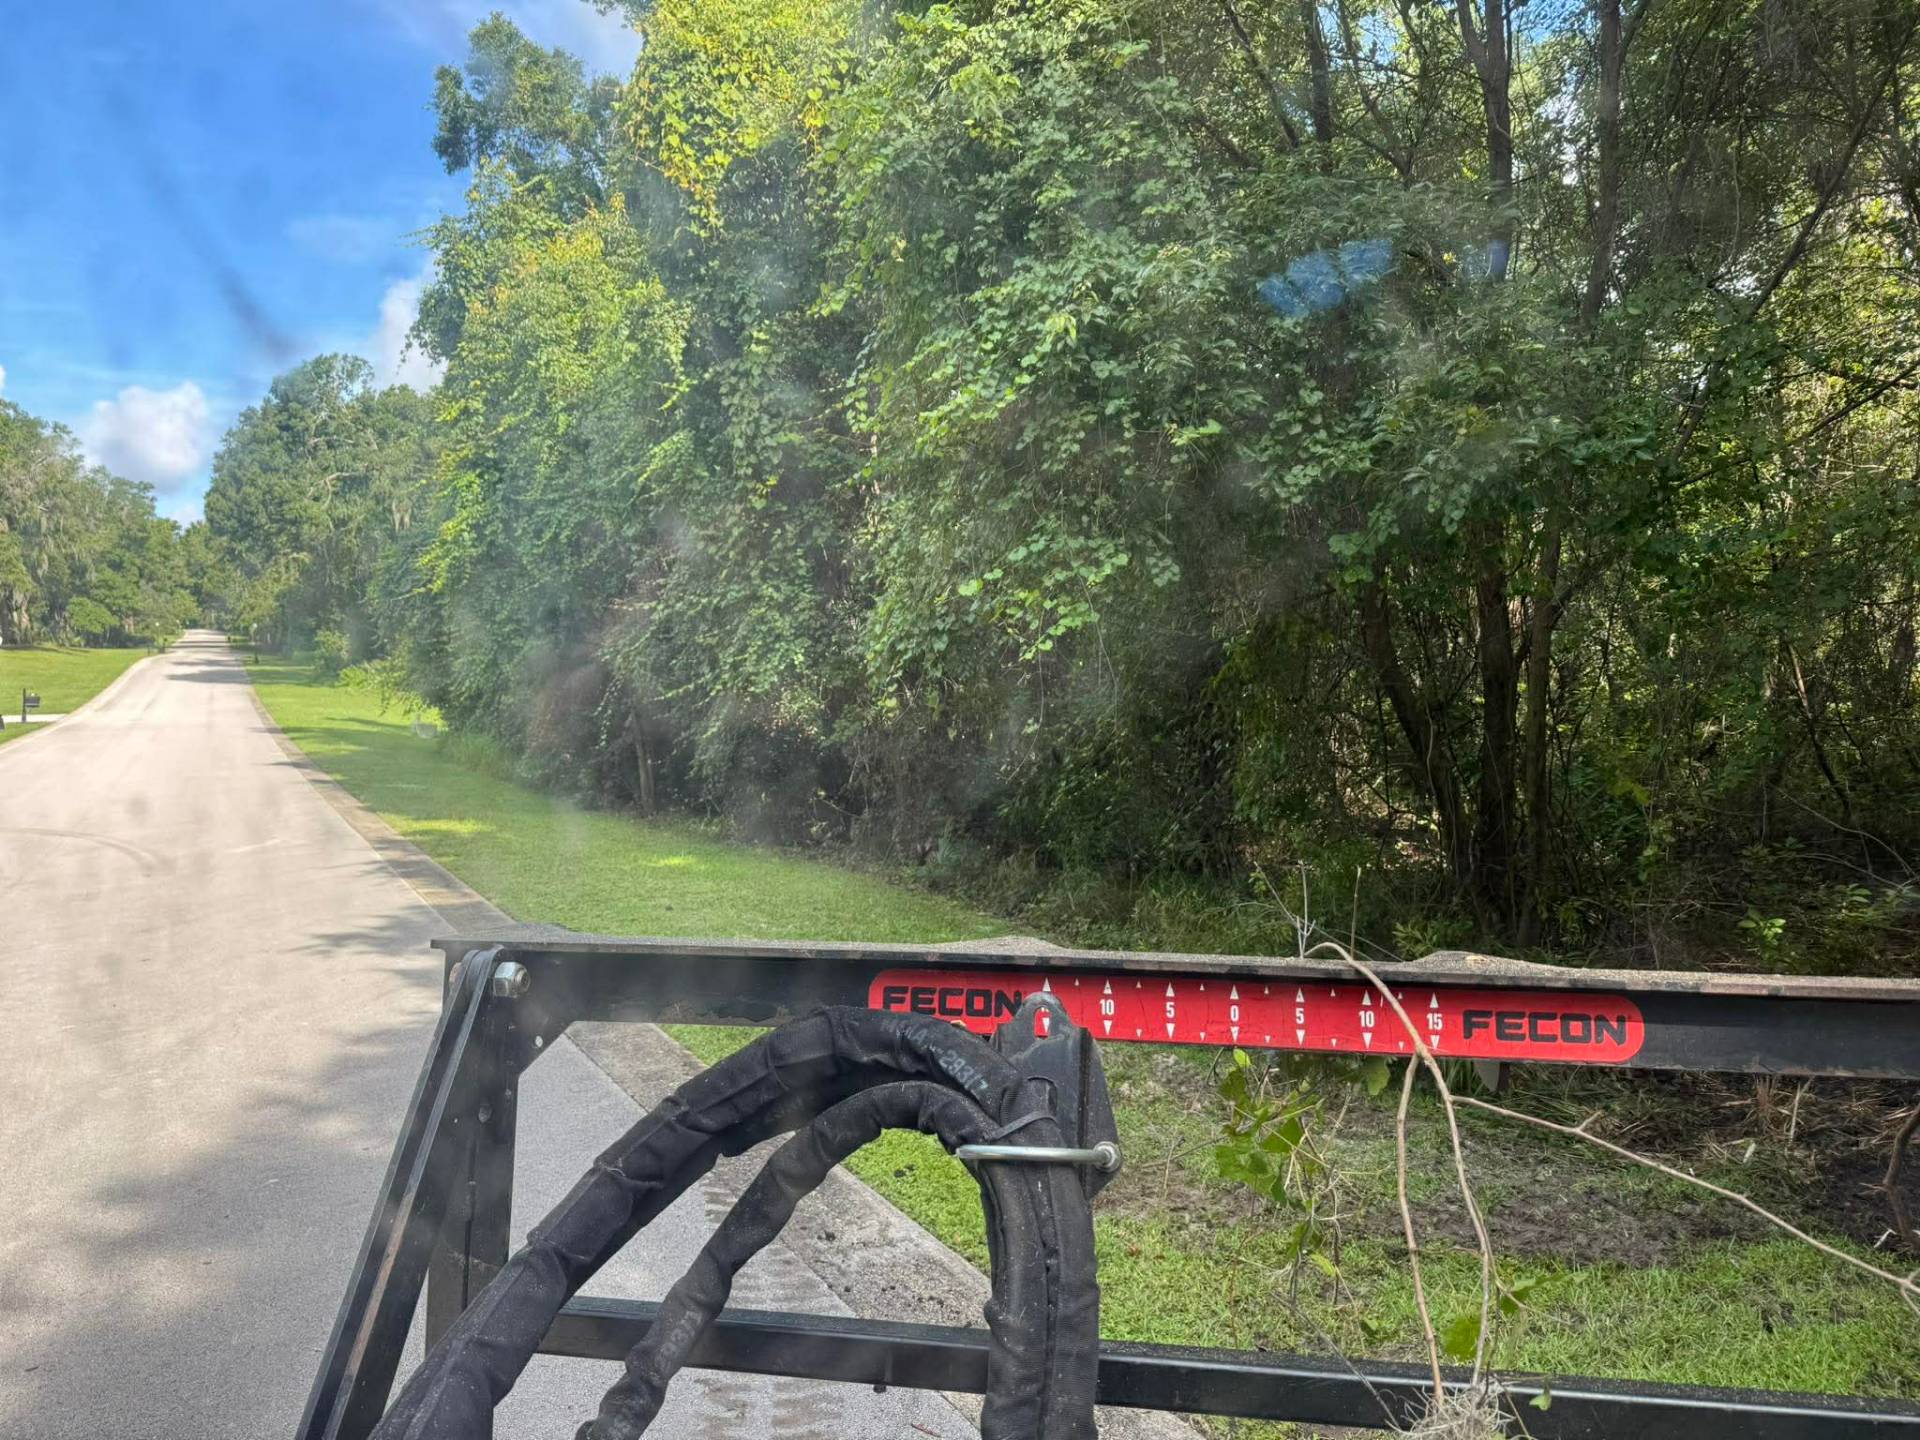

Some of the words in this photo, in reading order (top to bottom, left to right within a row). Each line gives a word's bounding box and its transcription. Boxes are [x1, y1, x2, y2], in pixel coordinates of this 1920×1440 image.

[883, 986, 1022, 1017] FECON
[1100, 999, 1114, 1016] 10
[1166, 1002, 1175, 1018] 5
[1230, 1005, 1239, 1022] 0
[1296, 1007, 1304, 1024] 5
[1359, 1010, 1375, 1028] 10
[1426, 1013, 1443, 1031] 15
[1462, 1009, 1627, 1047] FECON
